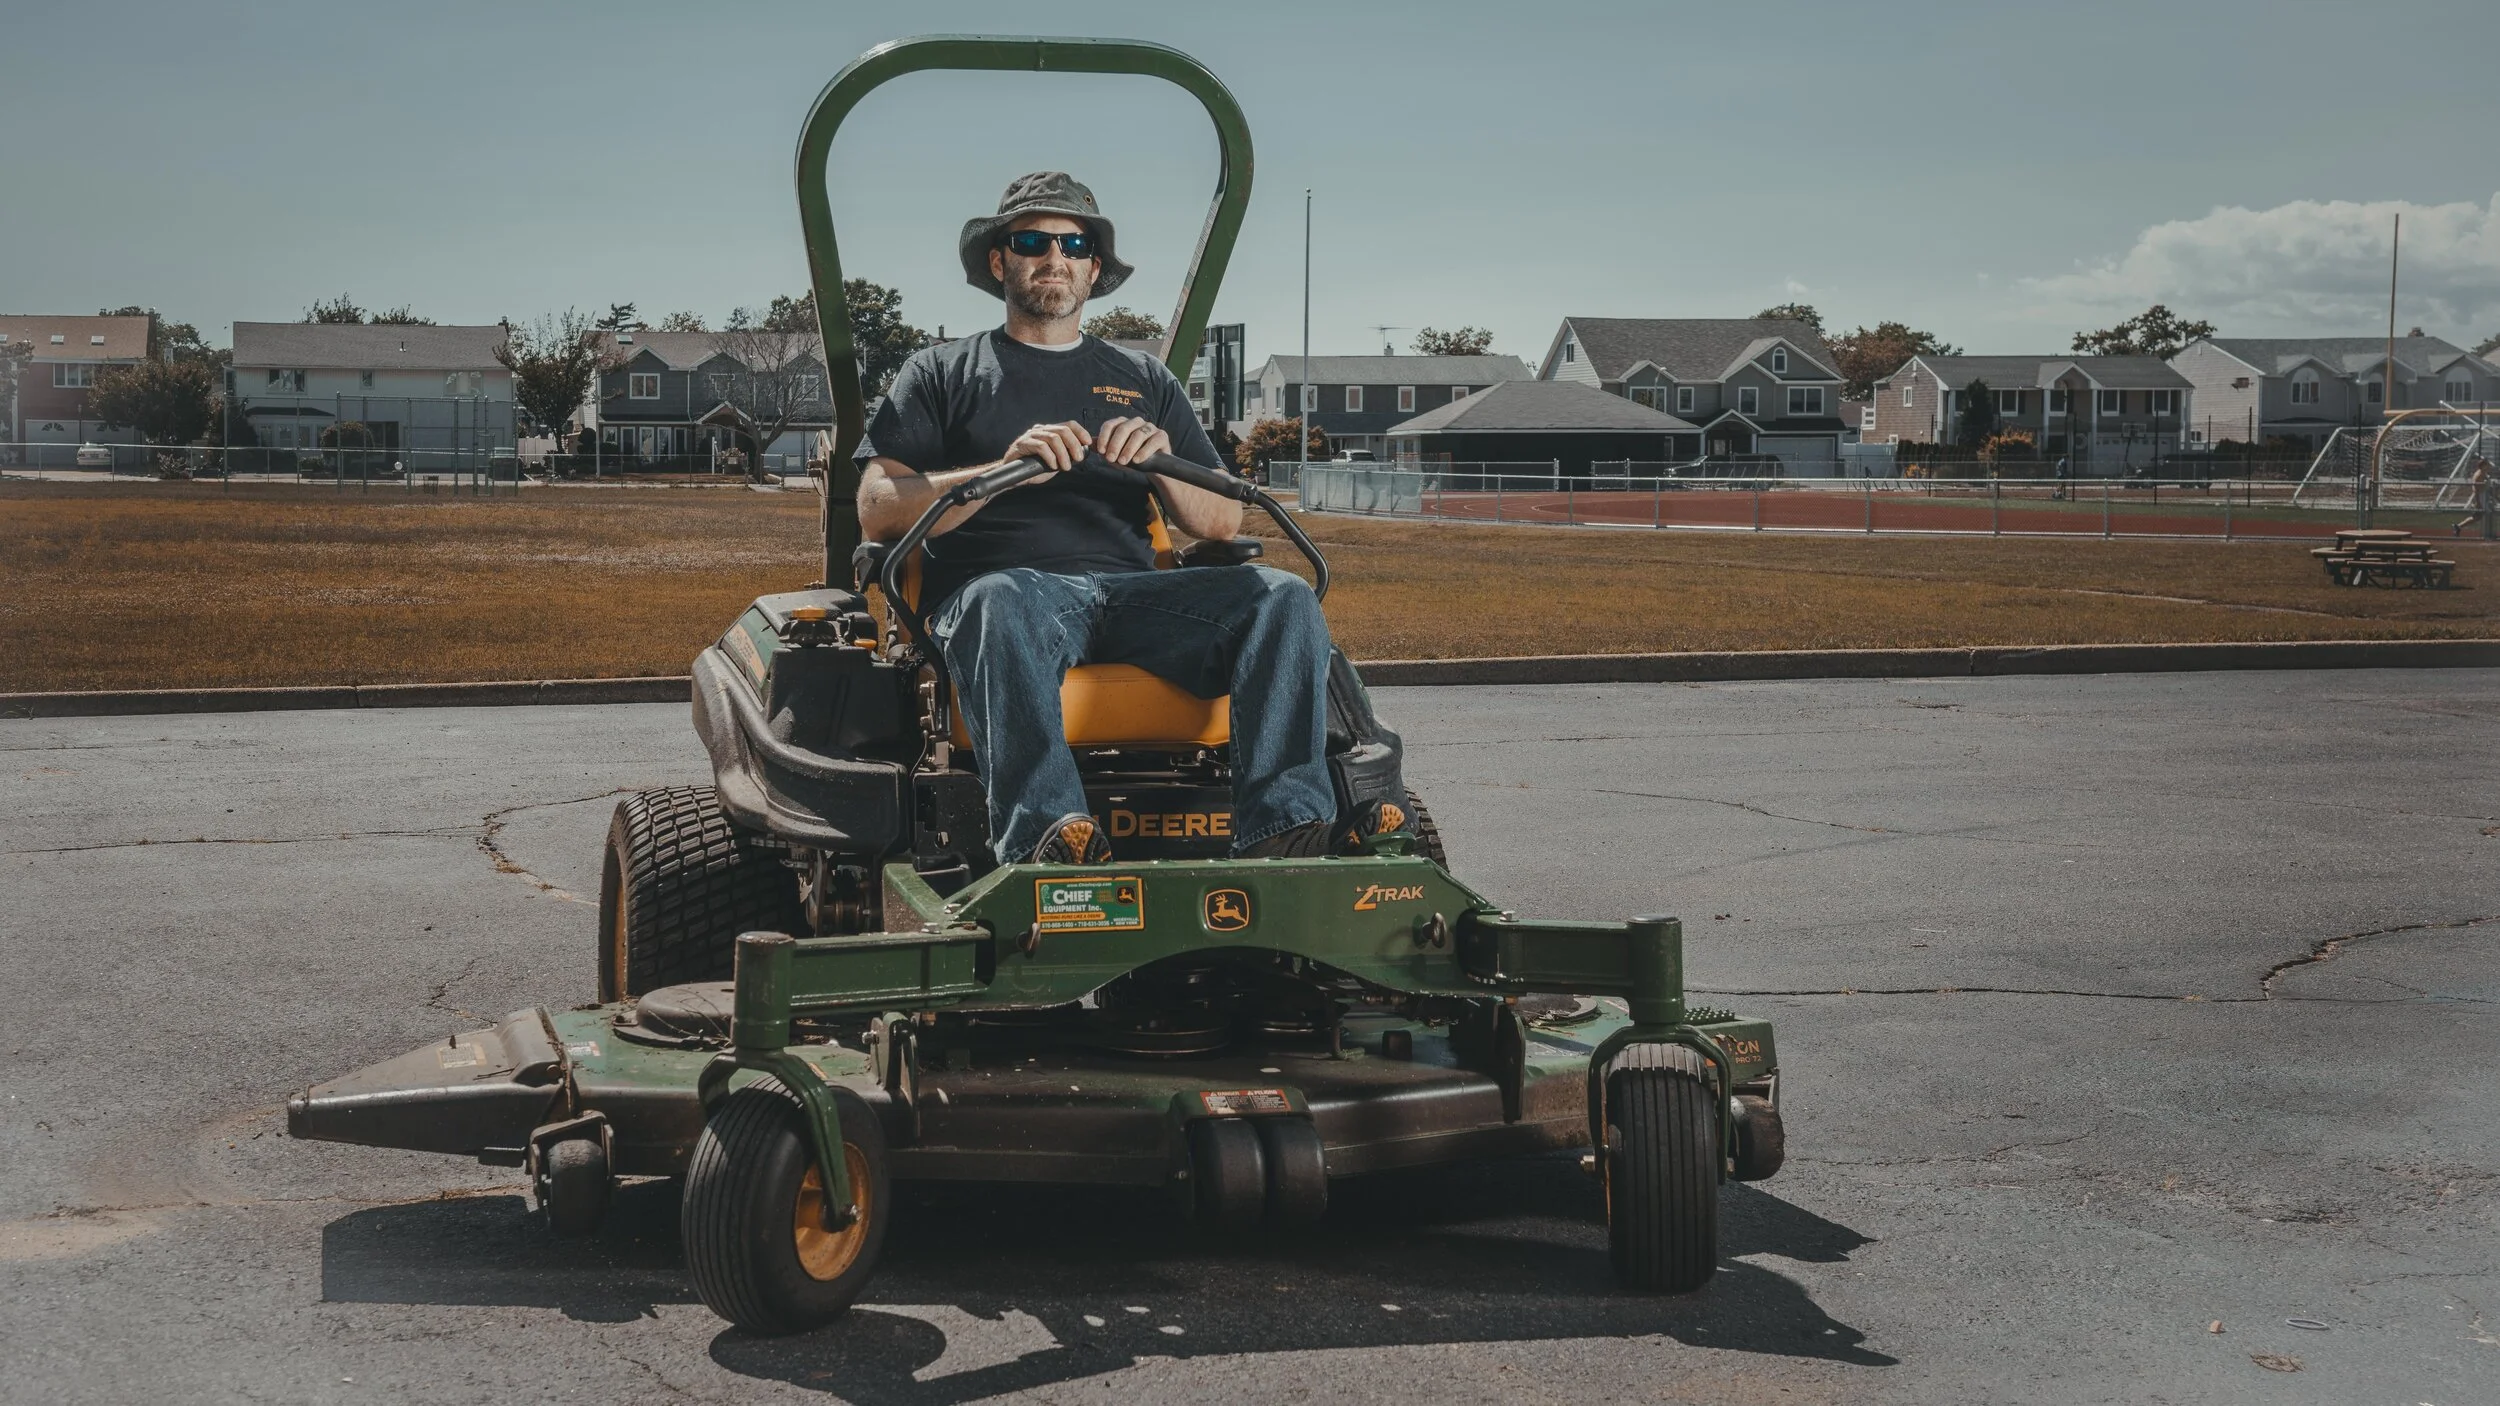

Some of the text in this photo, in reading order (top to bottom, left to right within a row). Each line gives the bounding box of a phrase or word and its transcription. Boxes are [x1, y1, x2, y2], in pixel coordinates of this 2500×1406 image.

[1111, 809, 1231, 836] DEERE
[1052, 889, 1092, 904] CHIEF
[1043, 904, 1086, 913] EQUIPMENT
[1735, 1056, 1751, 1064] PRO
